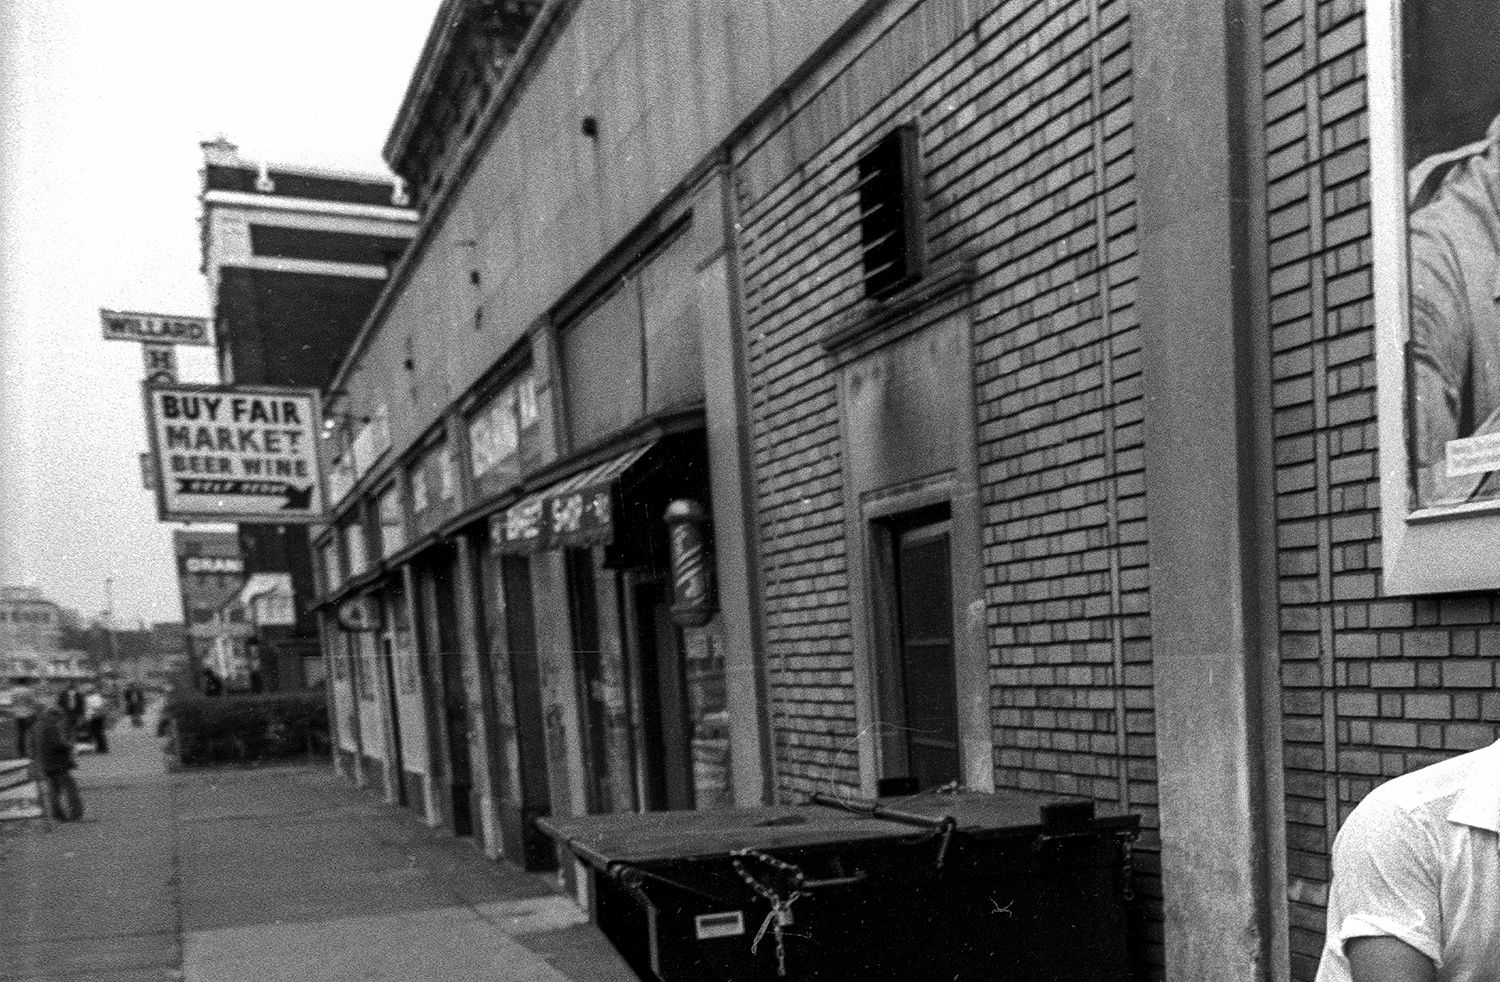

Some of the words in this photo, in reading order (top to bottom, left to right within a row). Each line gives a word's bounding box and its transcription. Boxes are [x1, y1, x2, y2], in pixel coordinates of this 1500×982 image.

[162, 395, 221, 421] BUY
[232, 399, 301, 424] FAIR
[166, 425, 303, 454] MARKET
[171, 454, 233, 475] BEER
[241, 458, 309, 478] WINE
